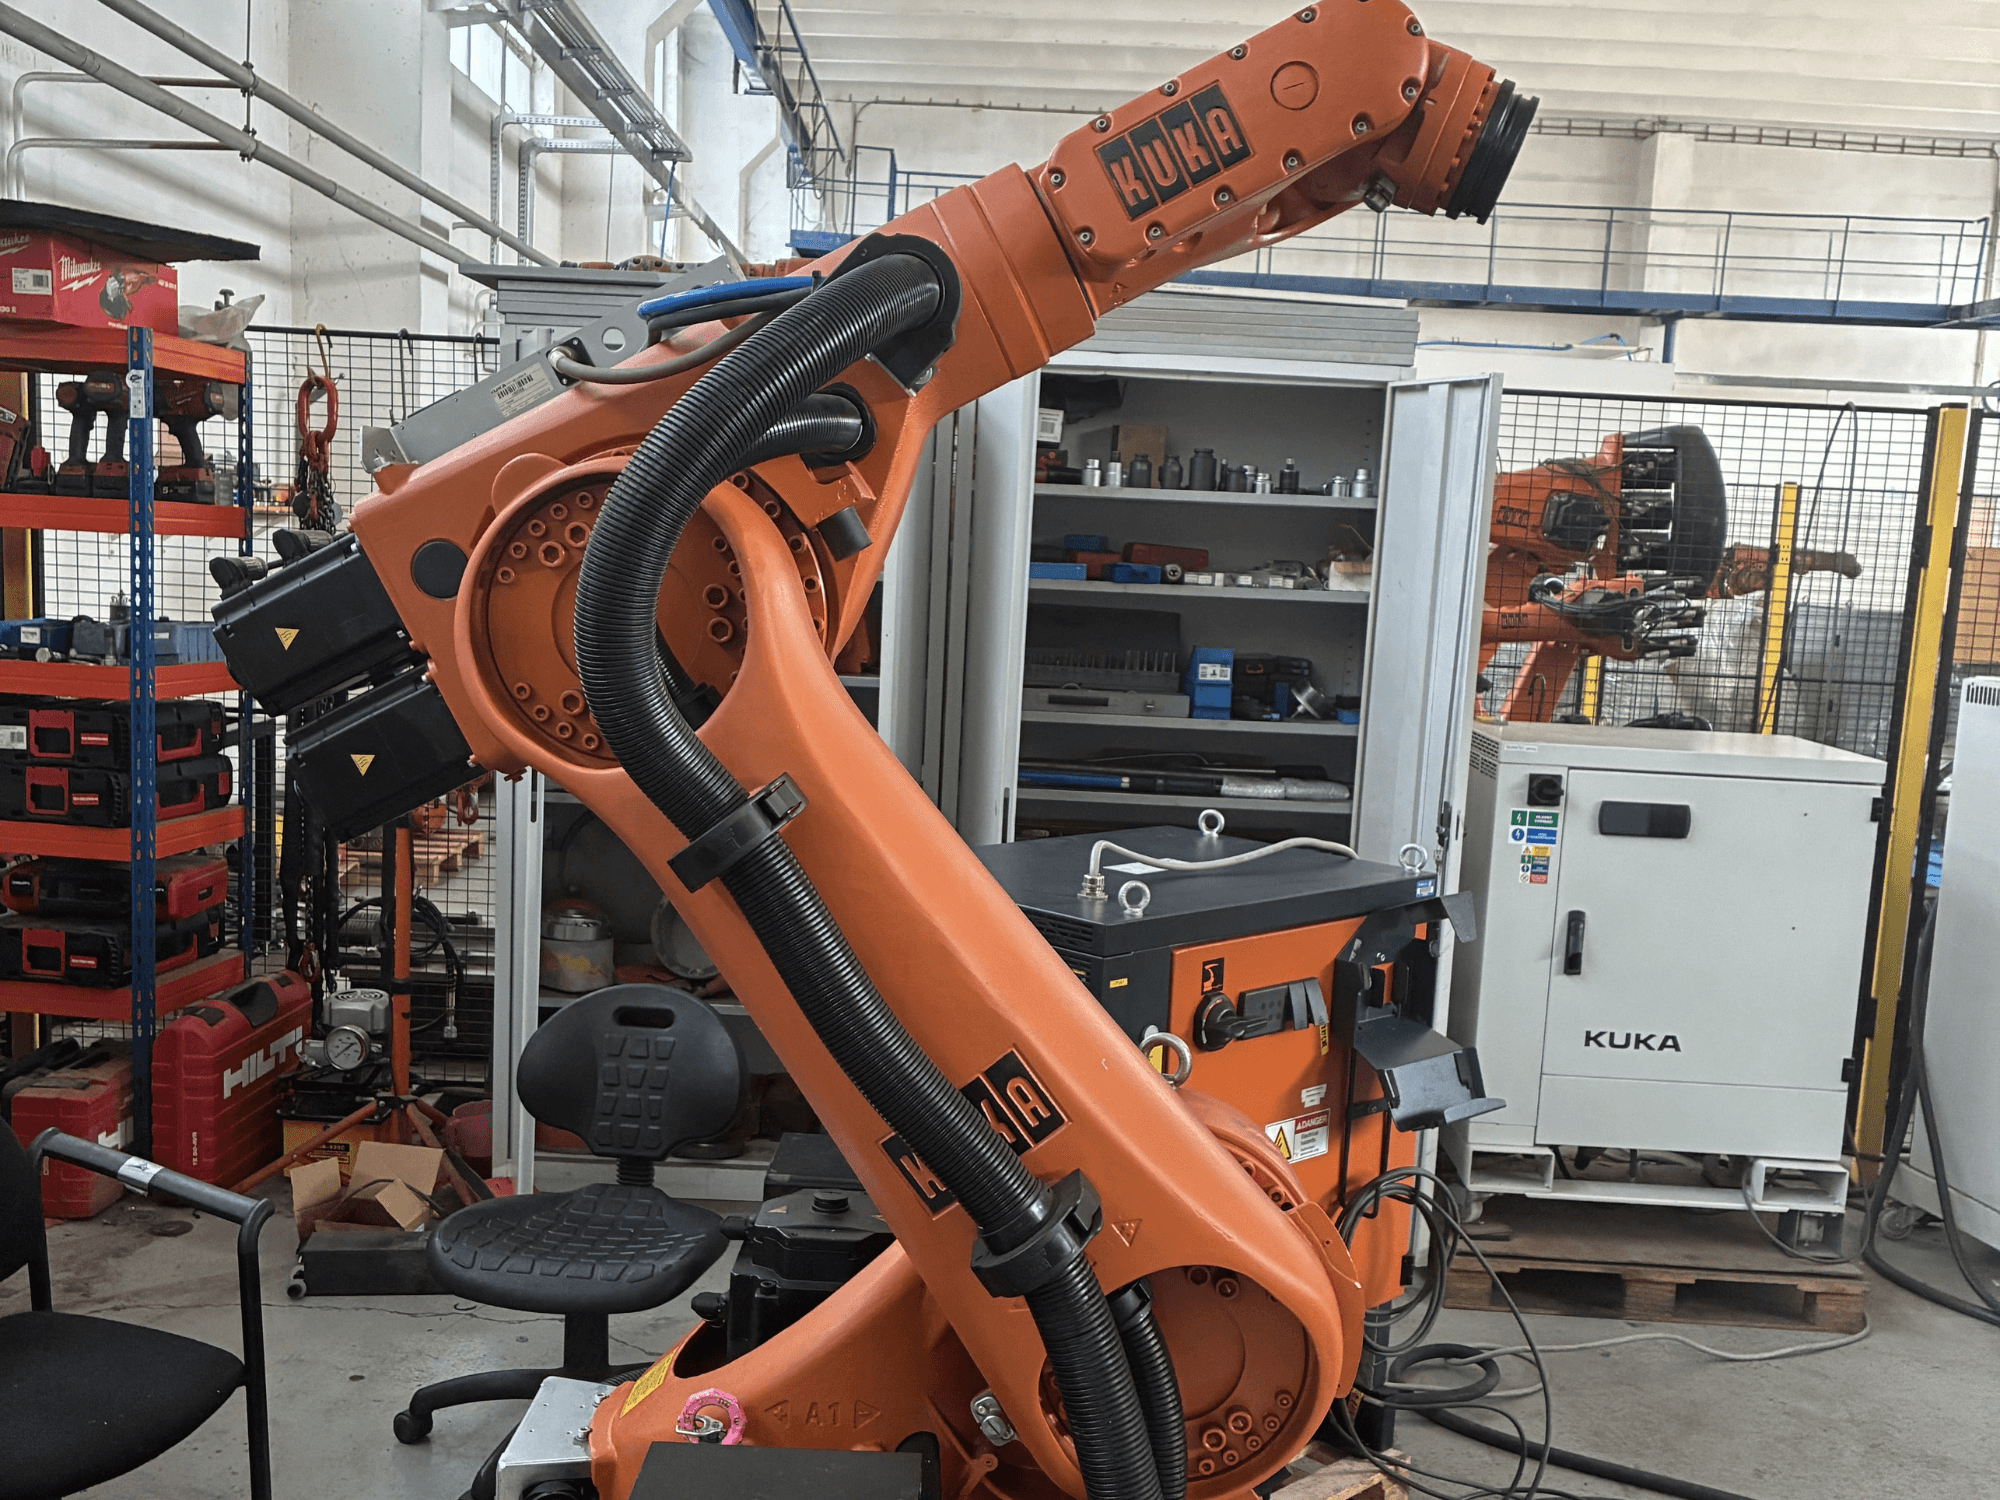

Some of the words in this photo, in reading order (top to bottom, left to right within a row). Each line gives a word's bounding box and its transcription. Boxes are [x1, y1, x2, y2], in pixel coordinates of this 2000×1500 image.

[1109, 107, 1244, 207] KUKA
[58, 254, 103, 282] Milwaukee
[1584, 1030, 1681, 1052] KUKA
[223, 1025, 303, 1100] HILTI
[1302, 1115, 1328, 1128] DANGER
[899, 1075, 1051, 1199] KA
[805, 1401, 842, 1427] A1
